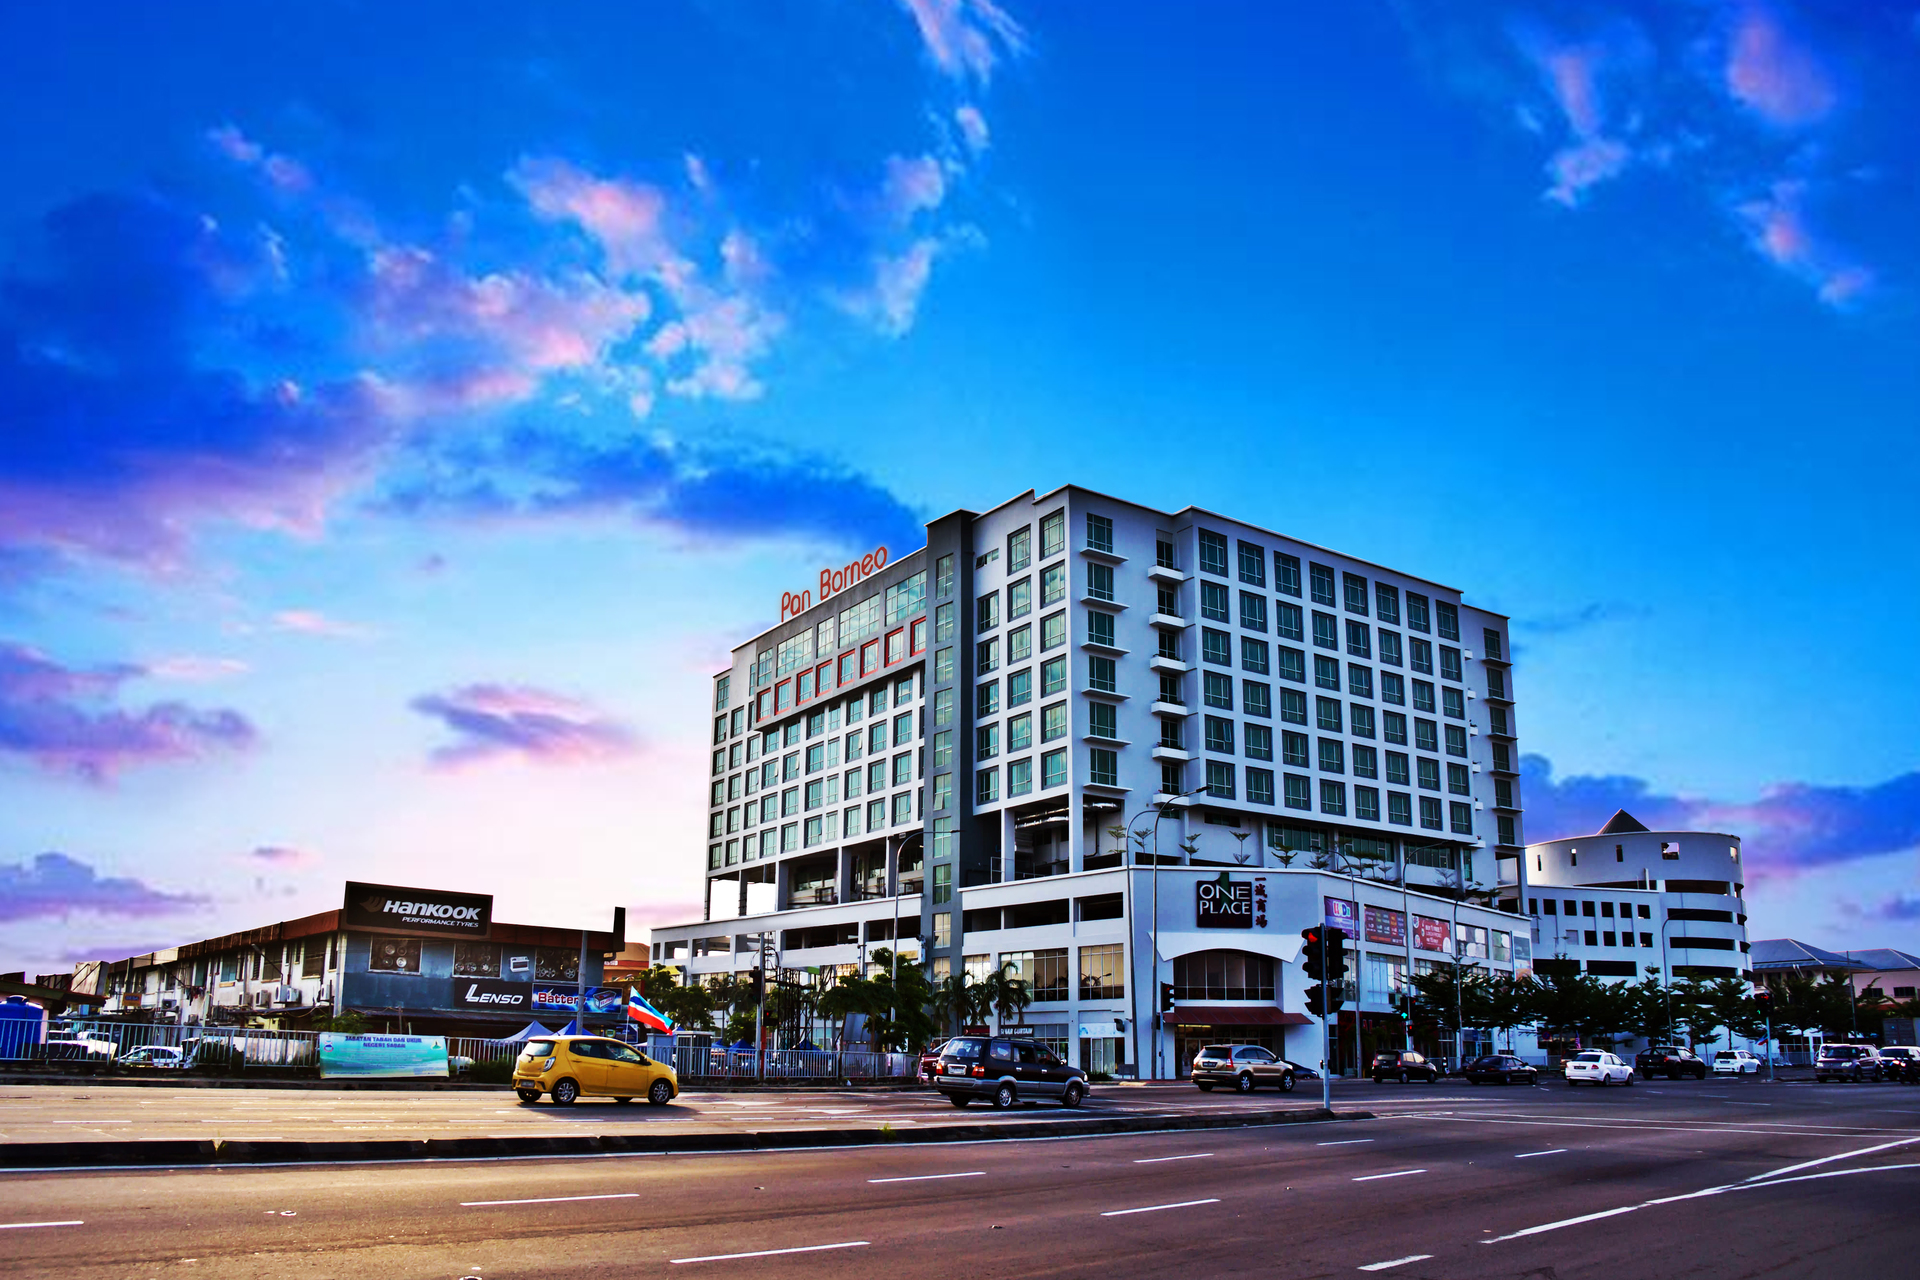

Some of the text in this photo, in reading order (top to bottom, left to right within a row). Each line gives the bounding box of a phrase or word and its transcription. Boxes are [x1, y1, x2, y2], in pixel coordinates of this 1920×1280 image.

[781, 546, 888, 623] Pan Borneo
[1200, 884, 1250, 900] ONE
[383, 900, 482, 920] HanKOOK
[1200, 900, 1251, 915] PLACE
[402, 916, 479, 928] PERFORMANCE TYRES
[465, 984, 523, 1004] LENSO
